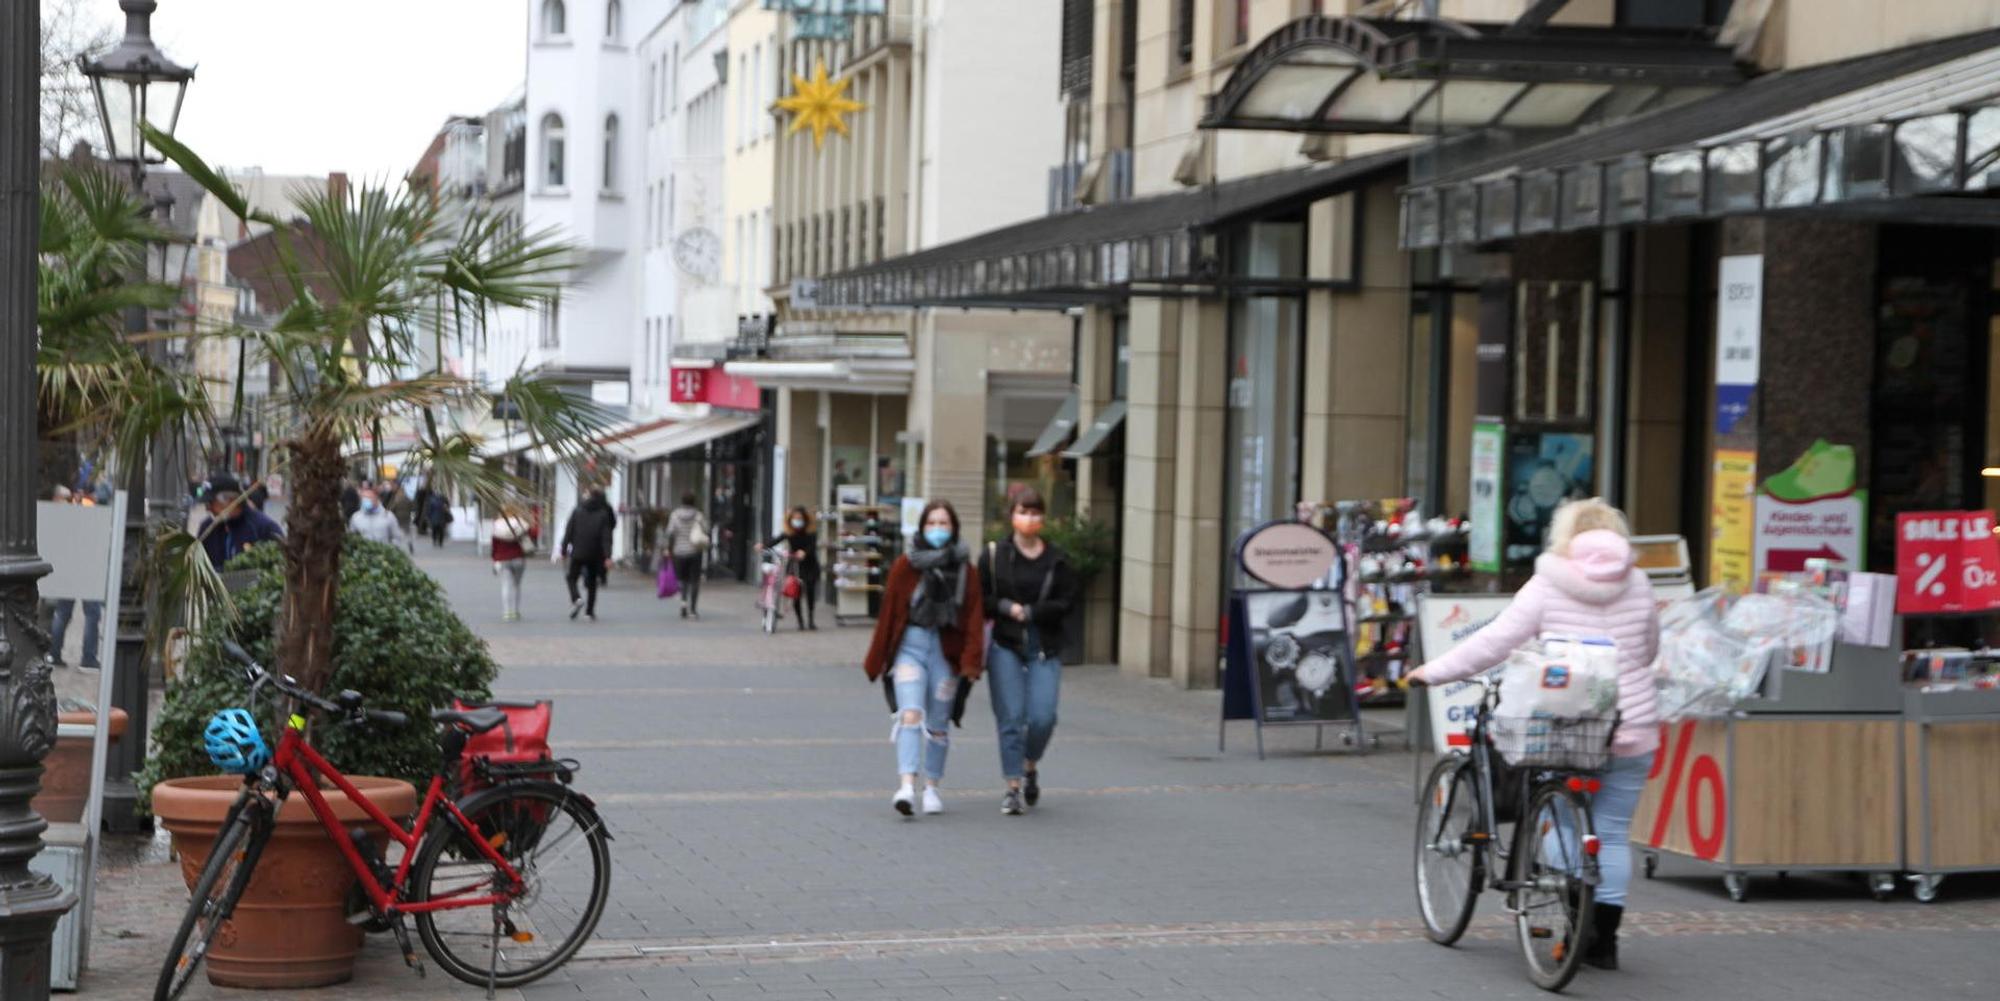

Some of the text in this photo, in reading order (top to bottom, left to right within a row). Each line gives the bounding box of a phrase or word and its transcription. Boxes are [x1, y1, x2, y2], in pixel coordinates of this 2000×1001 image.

[1770, 511, 1848, 523] Kinder- und
[1903, 519, 1959, 540] SALE
[1962, 517, 1991, 540] LE
[1914, 552, 1947, 596] %
